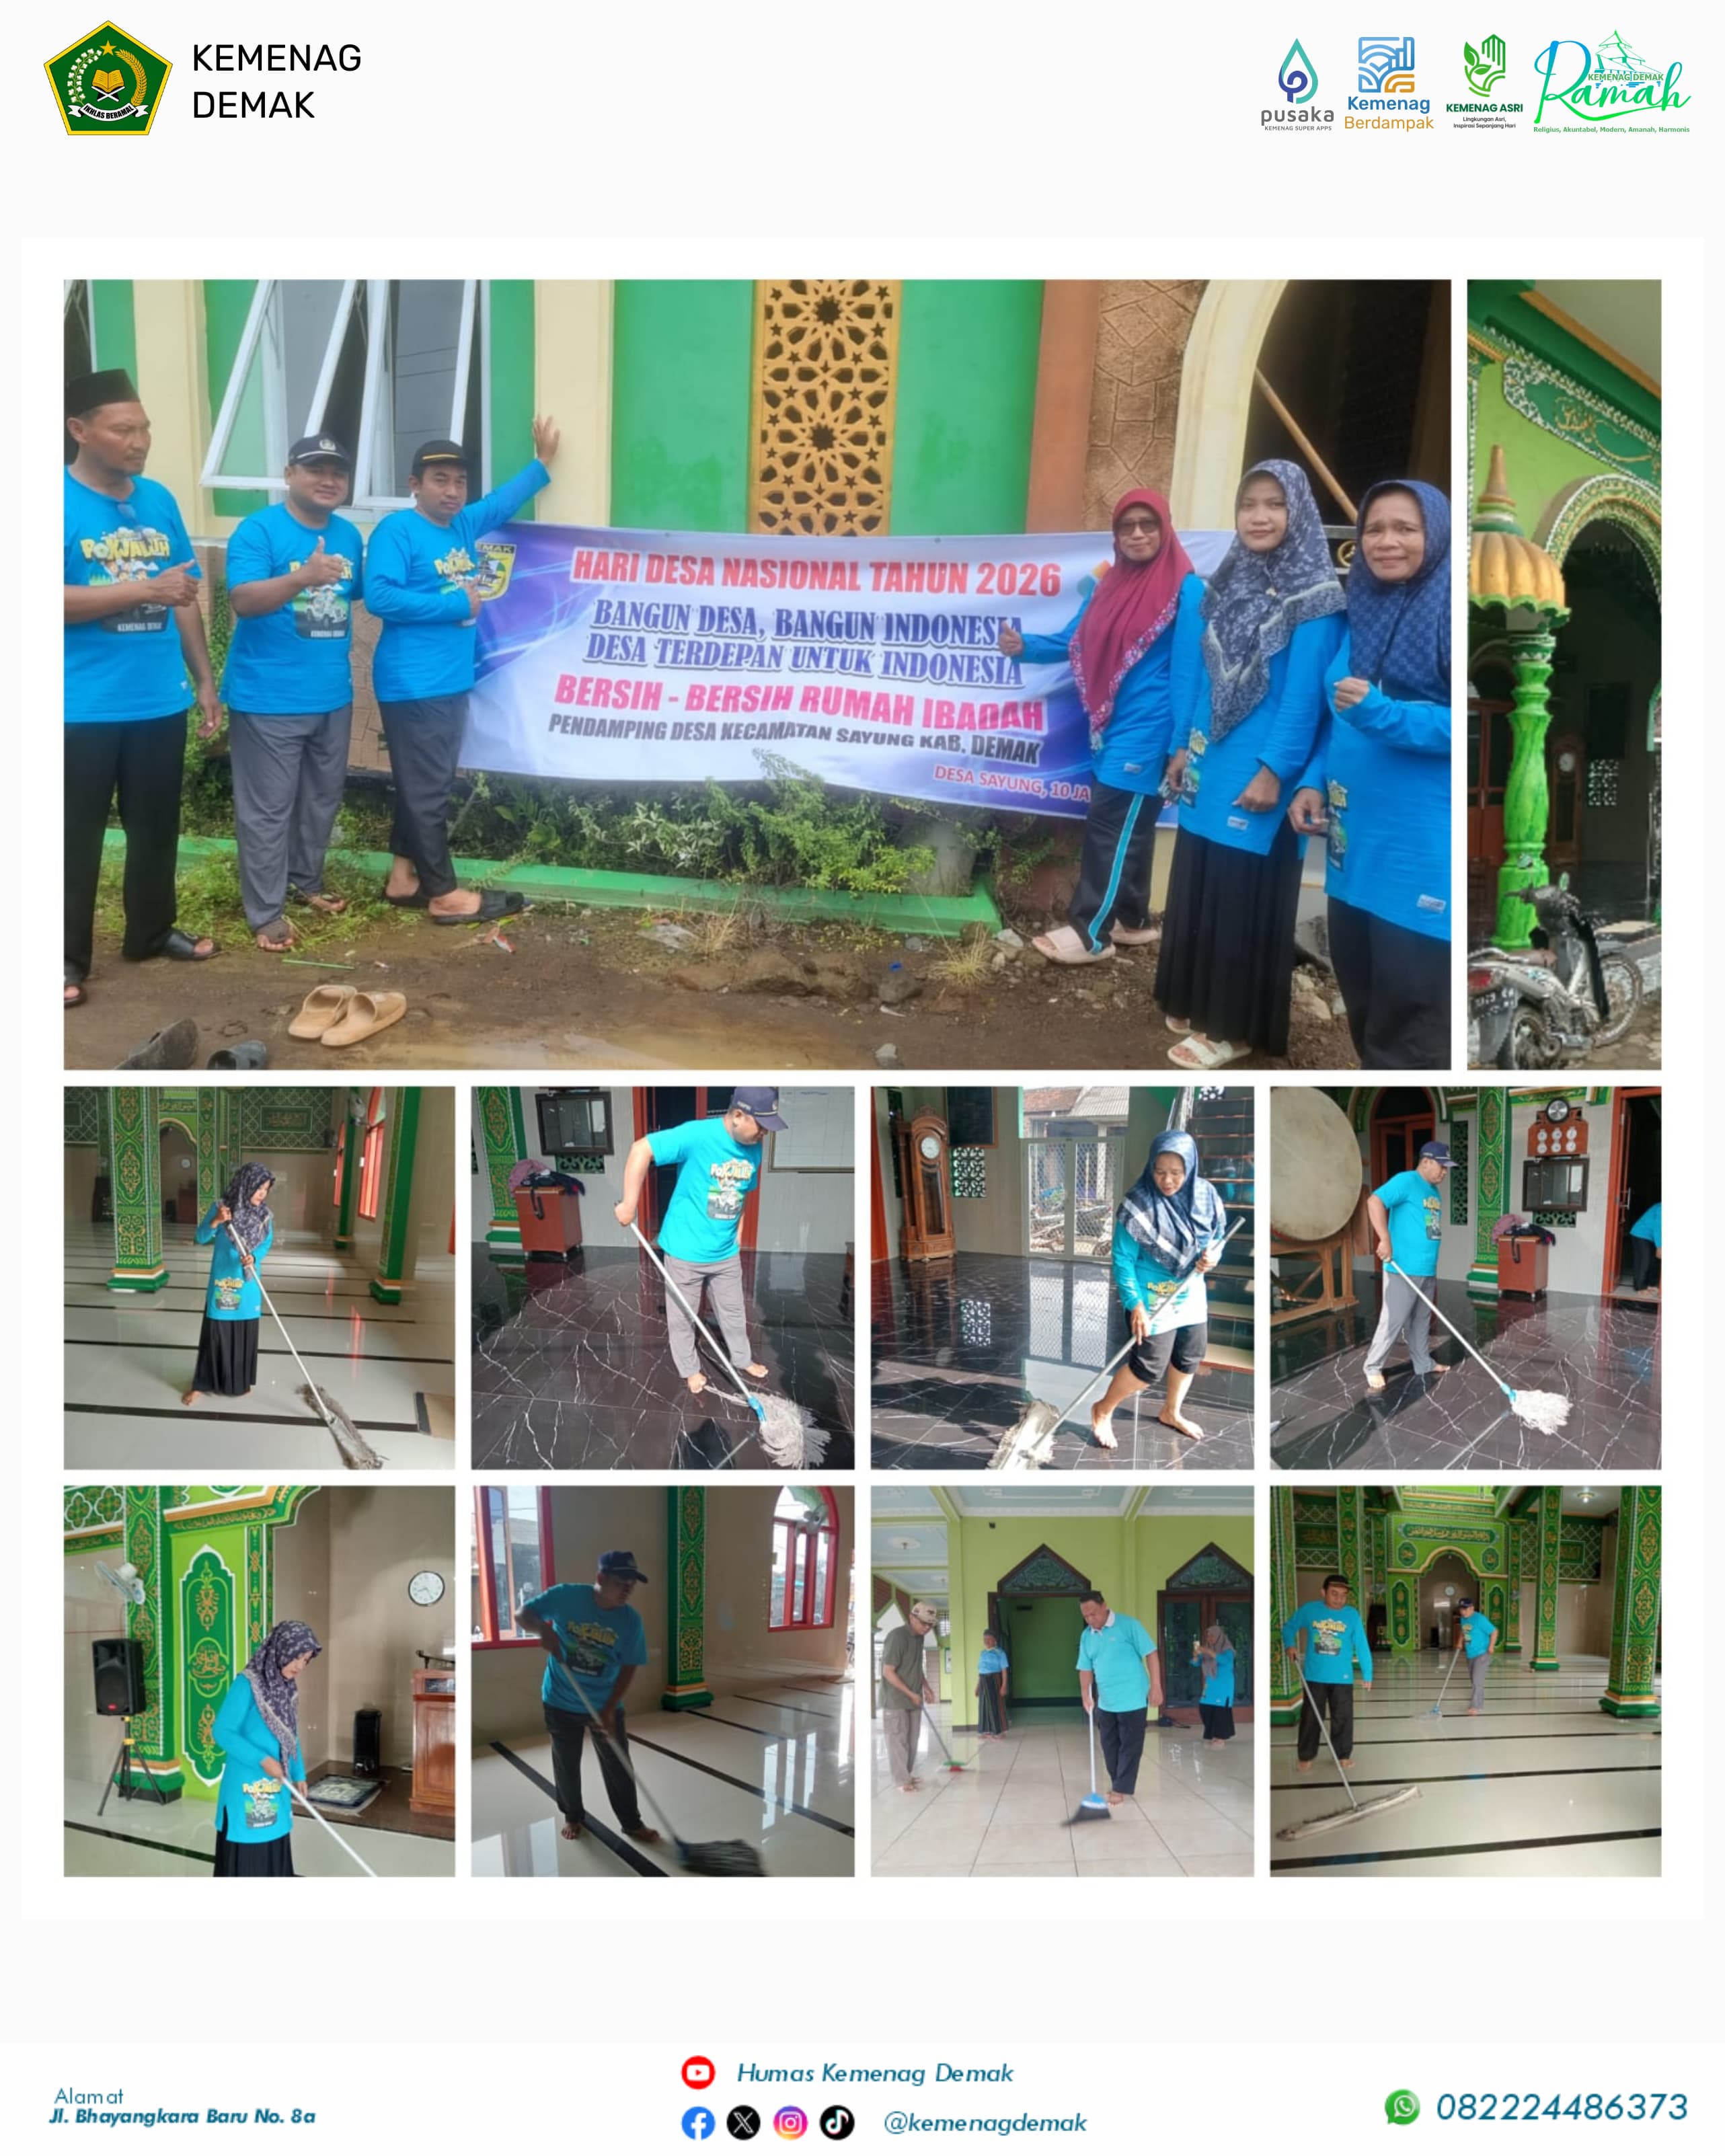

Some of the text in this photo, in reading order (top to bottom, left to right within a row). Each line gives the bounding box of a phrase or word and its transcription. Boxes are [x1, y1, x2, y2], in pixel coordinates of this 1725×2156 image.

[573, 549, 1061, 596] HARI DESA NASIONAL TAHUN 2026
[594, 599, 691, 630] BANGUN
[697, 605, 767, 640] DESA,
[775, 608, 876, 640] BANGUN
[587, 633, 1022, 685] DESA TERDEPAN UNTUK INDONESIA
[554, 674, 663, 711] BERSIH
[685, 684, 794, 713] BERSIH
[799, 685, 914, 726] RUMAH
[923, 698, 1044, 730] IBADAH
[548, 714, 1040, 765] PENDAMPING DESA KECAMATAN SAYUNG KAB. DEMAK
[935, 766, 974, 783] DESA
[979, 773, 1046, 797] SAYUNG,
[1051, 783, 1070, 797] 10
